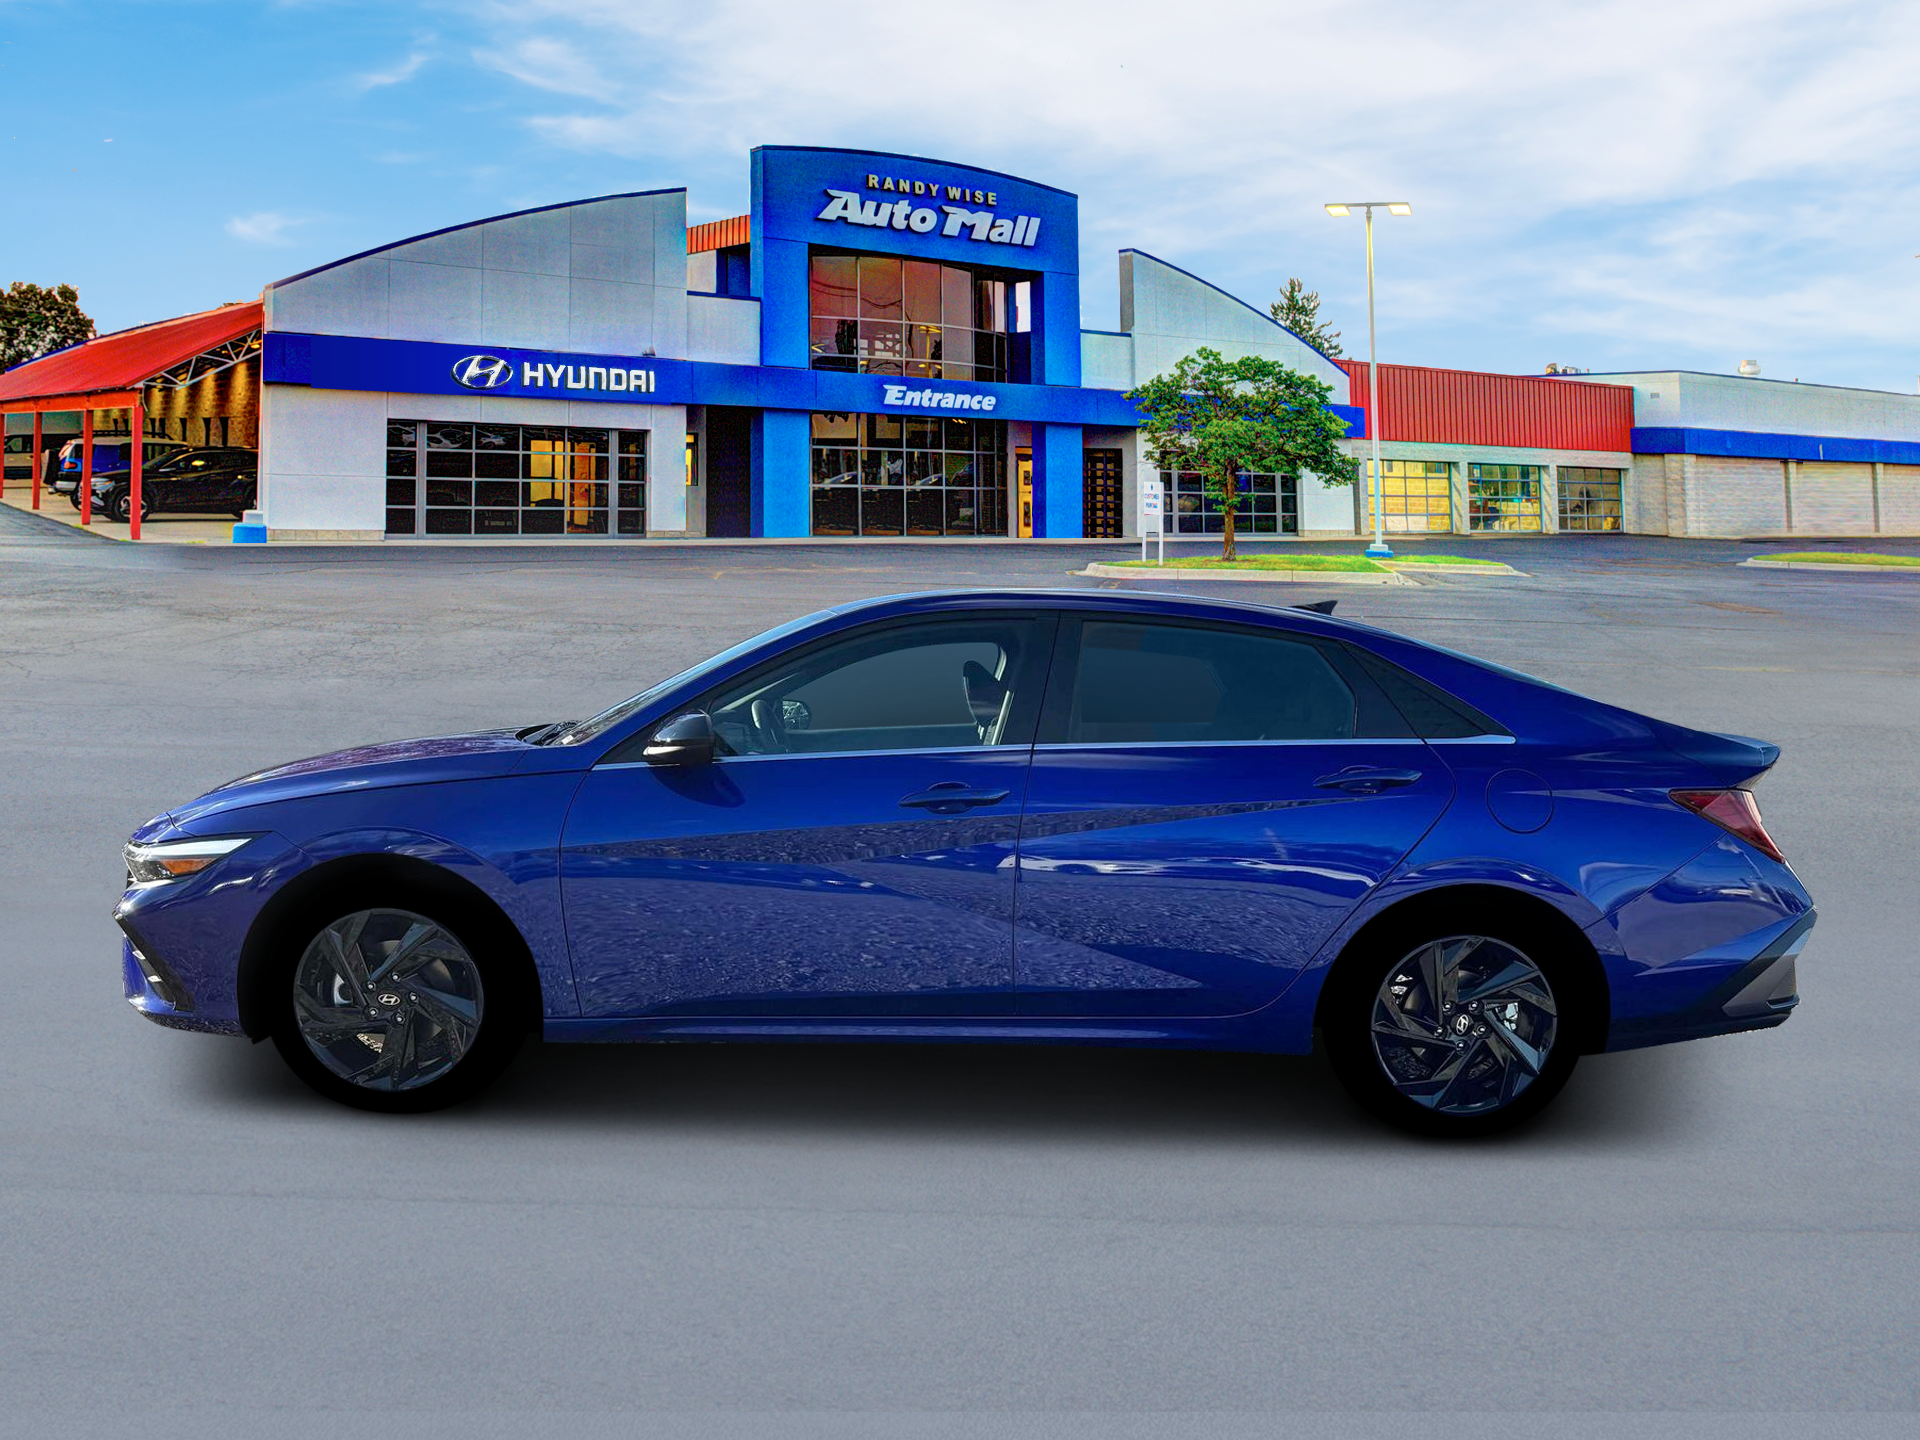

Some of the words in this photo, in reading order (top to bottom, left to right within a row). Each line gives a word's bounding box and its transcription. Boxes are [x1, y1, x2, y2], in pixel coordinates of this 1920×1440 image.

[867, 174, 939, 197] RANDY
[947, 186, 997, 206] WISE
[817, 189, 938, 233] Auto
[941, 205, 1041, 247] Mall
[523, 361, 656, 393] HYUNDAI
[882, 384, 997, 411] Entrance
